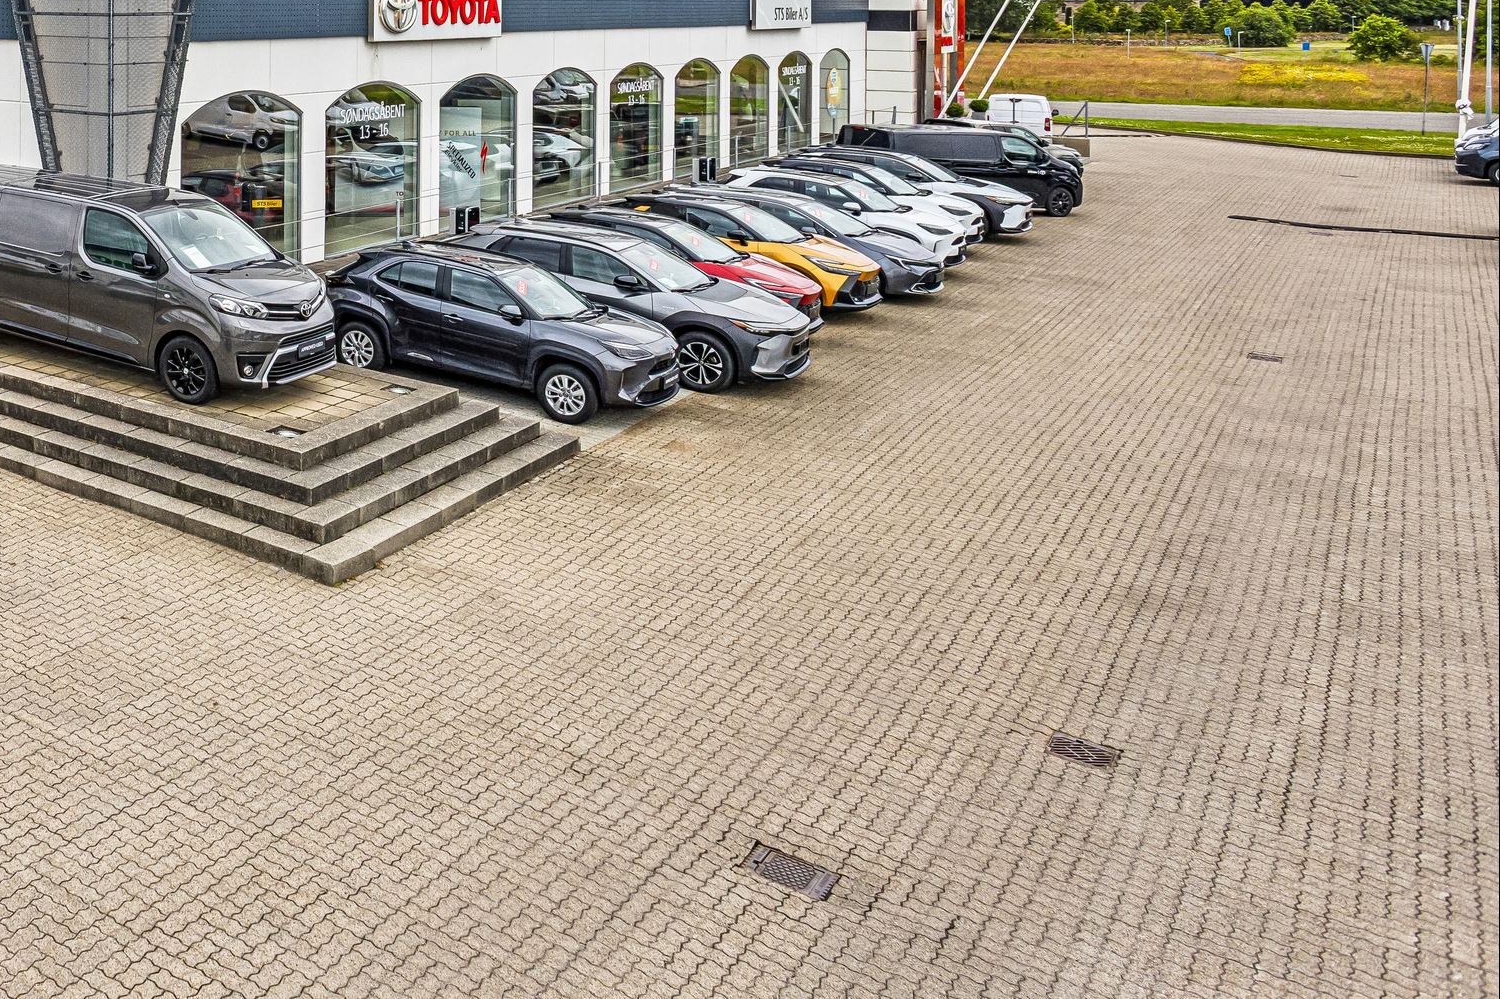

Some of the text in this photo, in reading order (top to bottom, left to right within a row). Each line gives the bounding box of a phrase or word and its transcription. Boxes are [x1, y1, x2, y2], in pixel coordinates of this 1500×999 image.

[774, 7, 808, 22] STS Biler A/S
[340, 100, 406, 124] SØNDAGSÅBENT
[360, 125, 370, 139] 13
[380, 122, 389, 136] 16
[447, 142, 476, 179] SPECIALIZED
